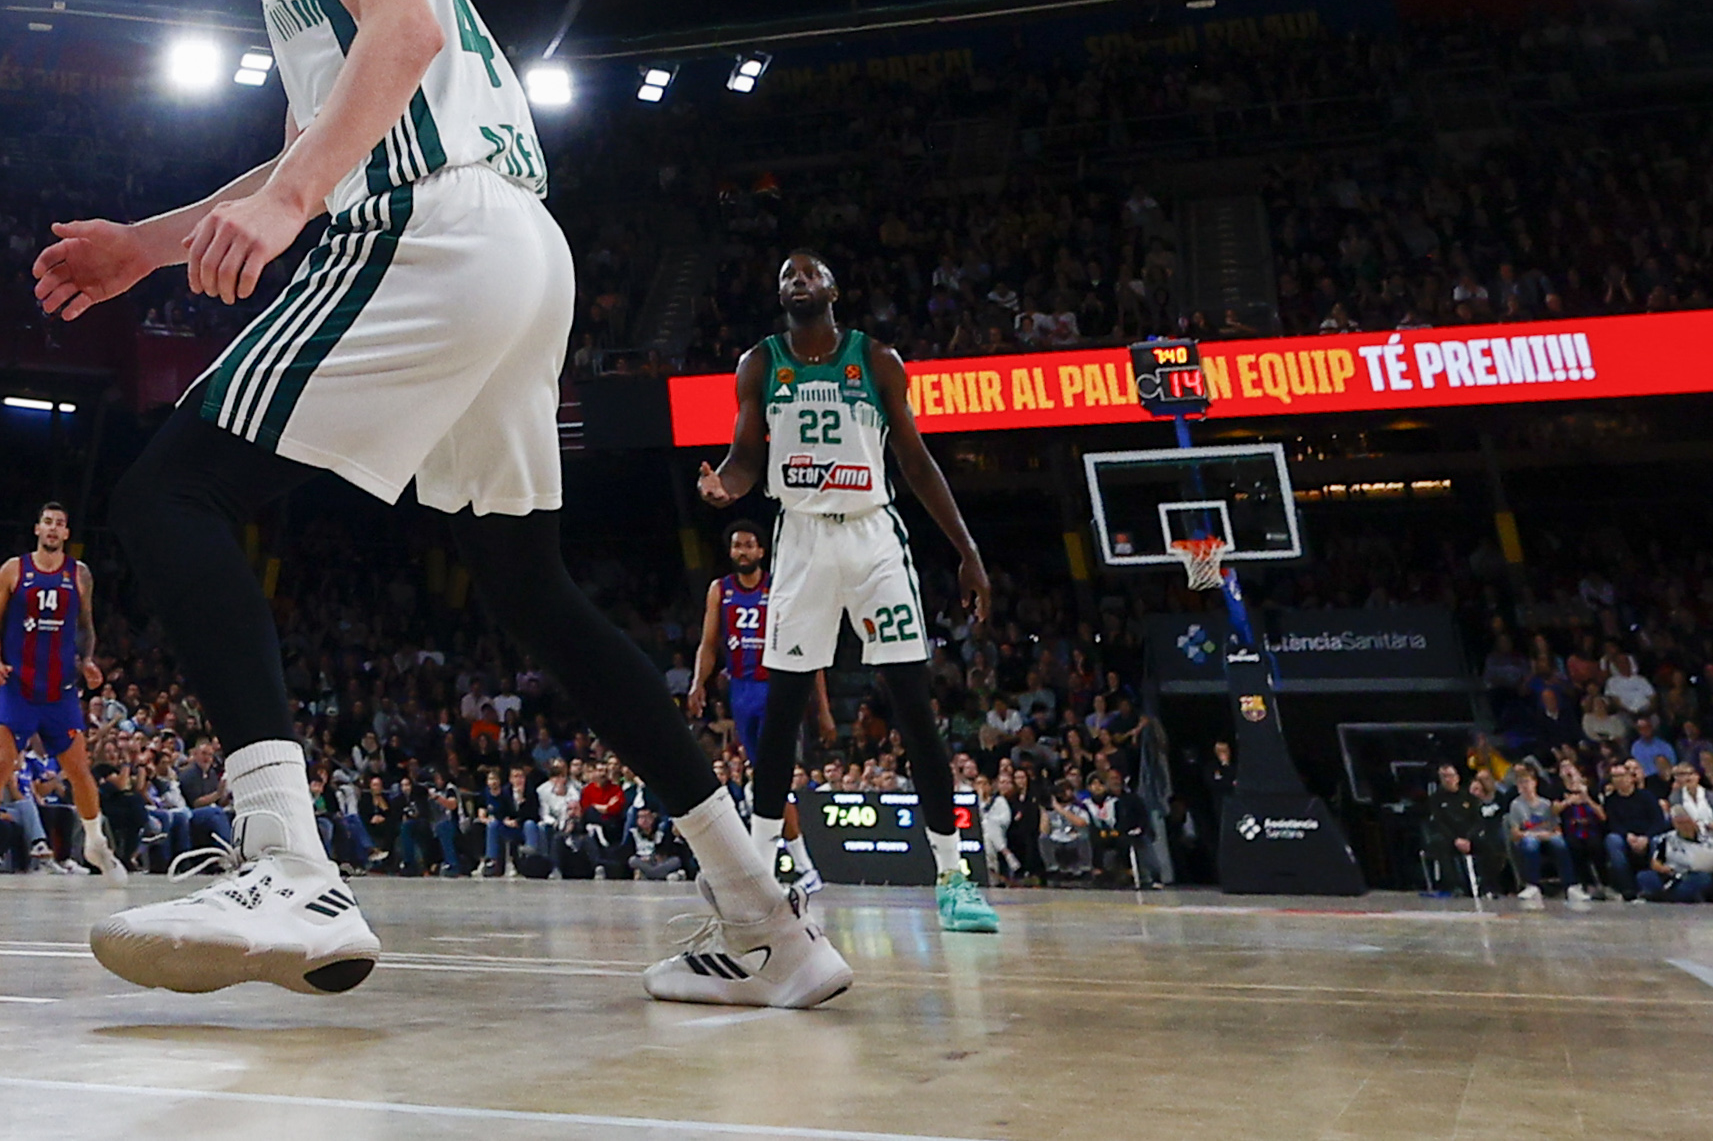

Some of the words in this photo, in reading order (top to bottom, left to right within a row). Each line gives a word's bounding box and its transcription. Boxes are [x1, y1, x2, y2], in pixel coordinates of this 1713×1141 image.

[1153, 347, 1188, 364] 7:40
[910, 371, 1005, 417] VENIR
[1011, 367, 1054, 411] AL
[1237, 348, 1355, 404] EQUIP
[1359, 333, 1413, 391] TÉ
[1414, 332, 1596, 389] PREMI!!!
[1169, 370, 1205, 397] 14
[799, 409, 842, 444] 22
[36, 589, 58, 611] 14
[736, 607, 760, 628] 22
[875, 604, 918, 643] 22
[823, 805, 877, 827] 7:40
[897, 809, 913, 827] 2
[779, 855, 793, 872] 3
[958, 858, 971, 876] 1
